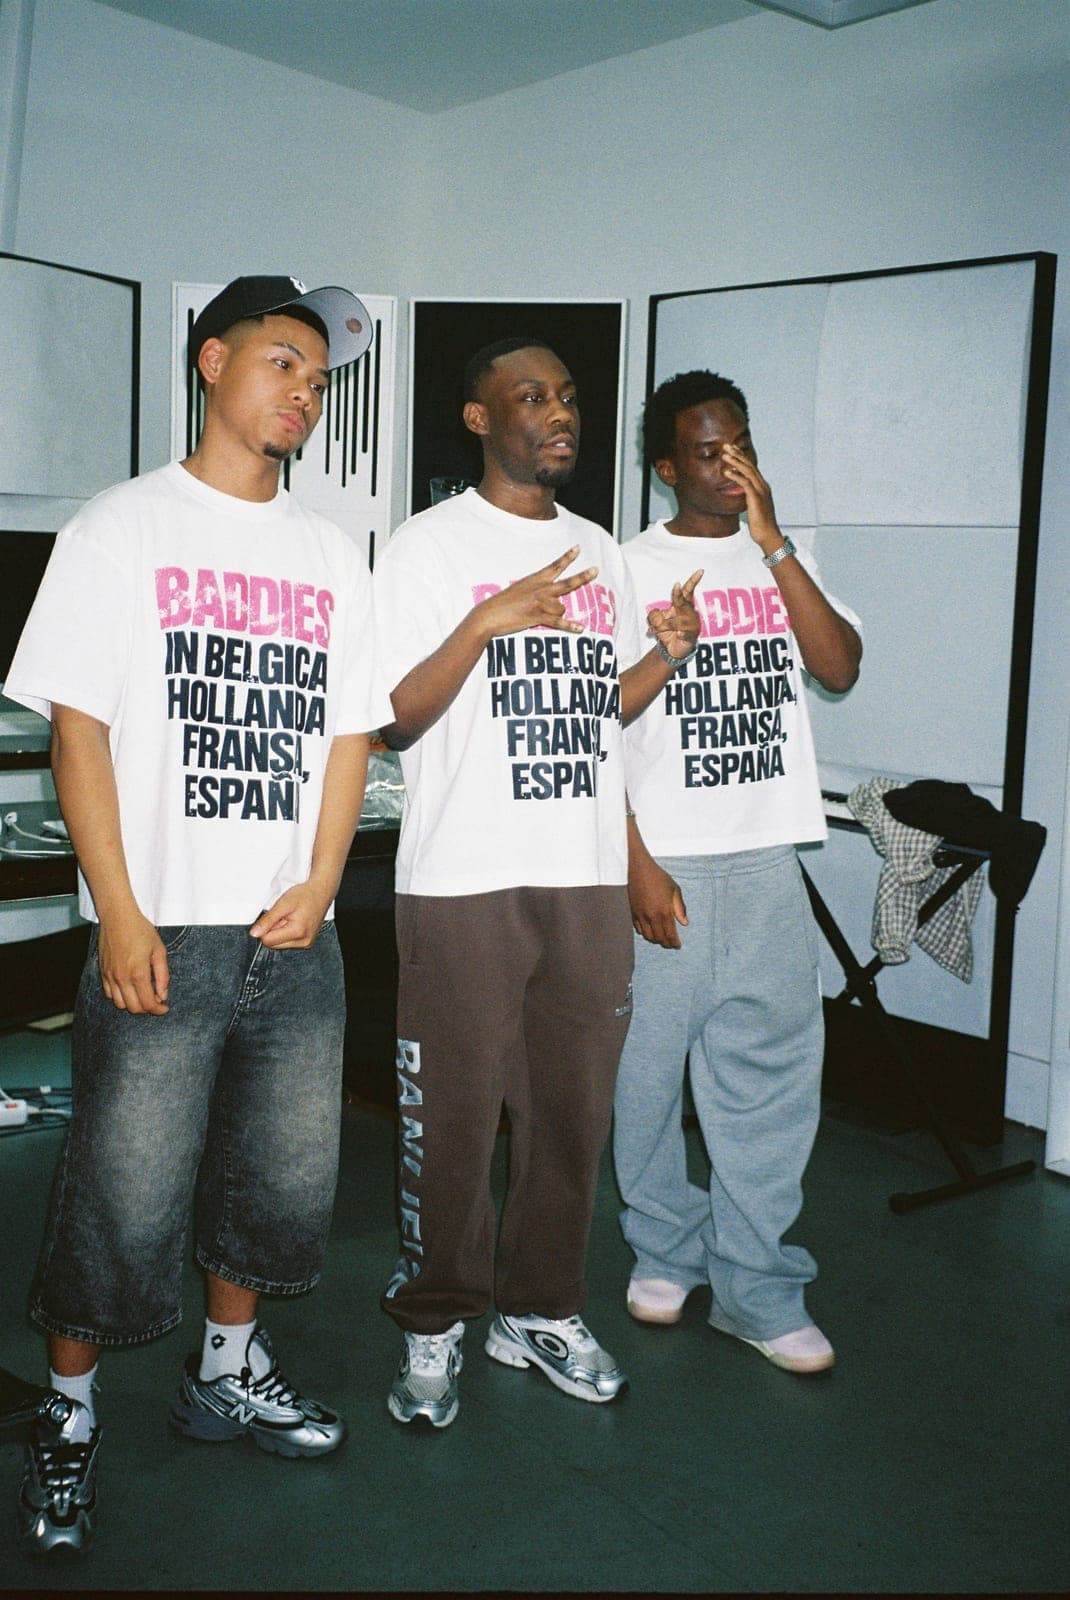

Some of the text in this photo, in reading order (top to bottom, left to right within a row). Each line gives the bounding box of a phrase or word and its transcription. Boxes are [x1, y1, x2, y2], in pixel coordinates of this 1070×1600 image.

[155, 566, 335, 649] BADDIES
[645, 587, 792, 638] DDIE
[165, 631, 327, 693] IN BELGICA
[486, 636, 617, 679] IN BELGC
[167, 678, 325, 736] HOLLANDA
[507, 717, 608, 762] FRAN,
[684, 742, 786, 788] ESPAÑA
[185, 771, 299, 824] ESPAÑ
[229, 1403, 256, 1424] N
